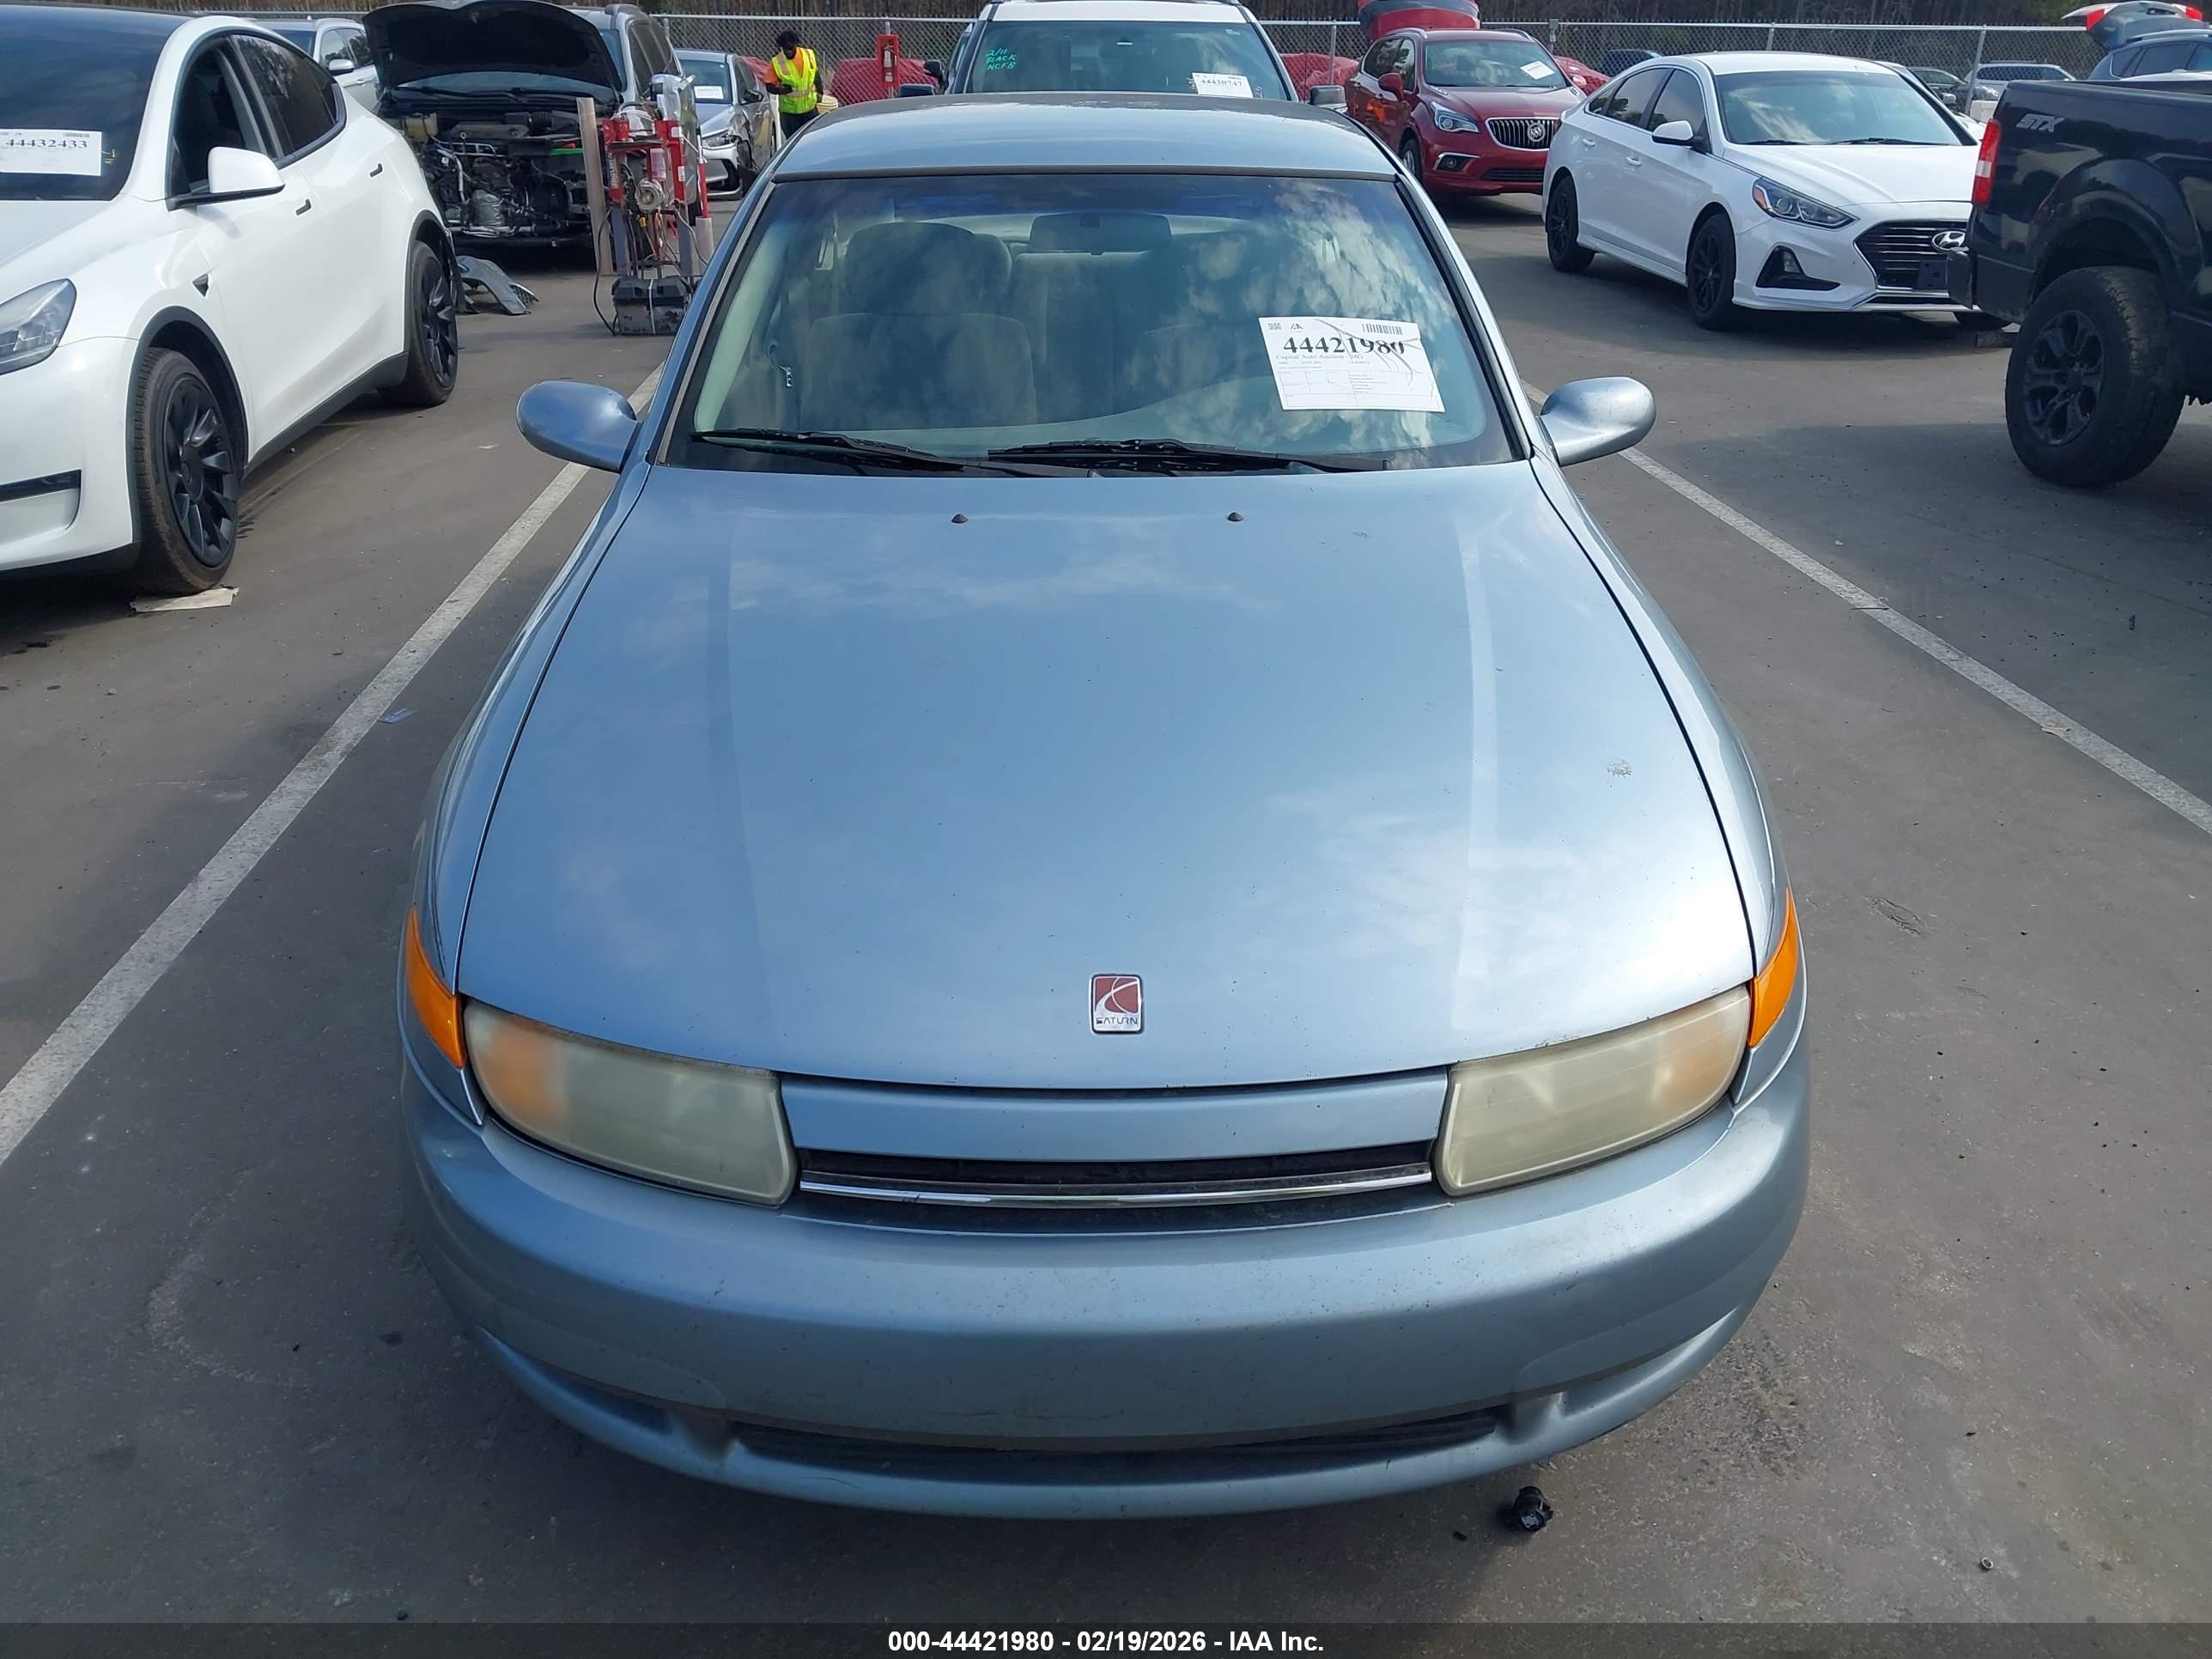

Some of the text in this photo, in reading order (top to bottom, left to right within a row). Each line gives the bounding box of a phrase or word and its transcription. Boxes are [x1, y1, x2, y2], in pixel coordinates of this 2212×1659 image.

[2015, 113, 2065, 133] STX
[5, 138, 88, 149] 44432433
[1284, 337, 1405, 355] 44421980
